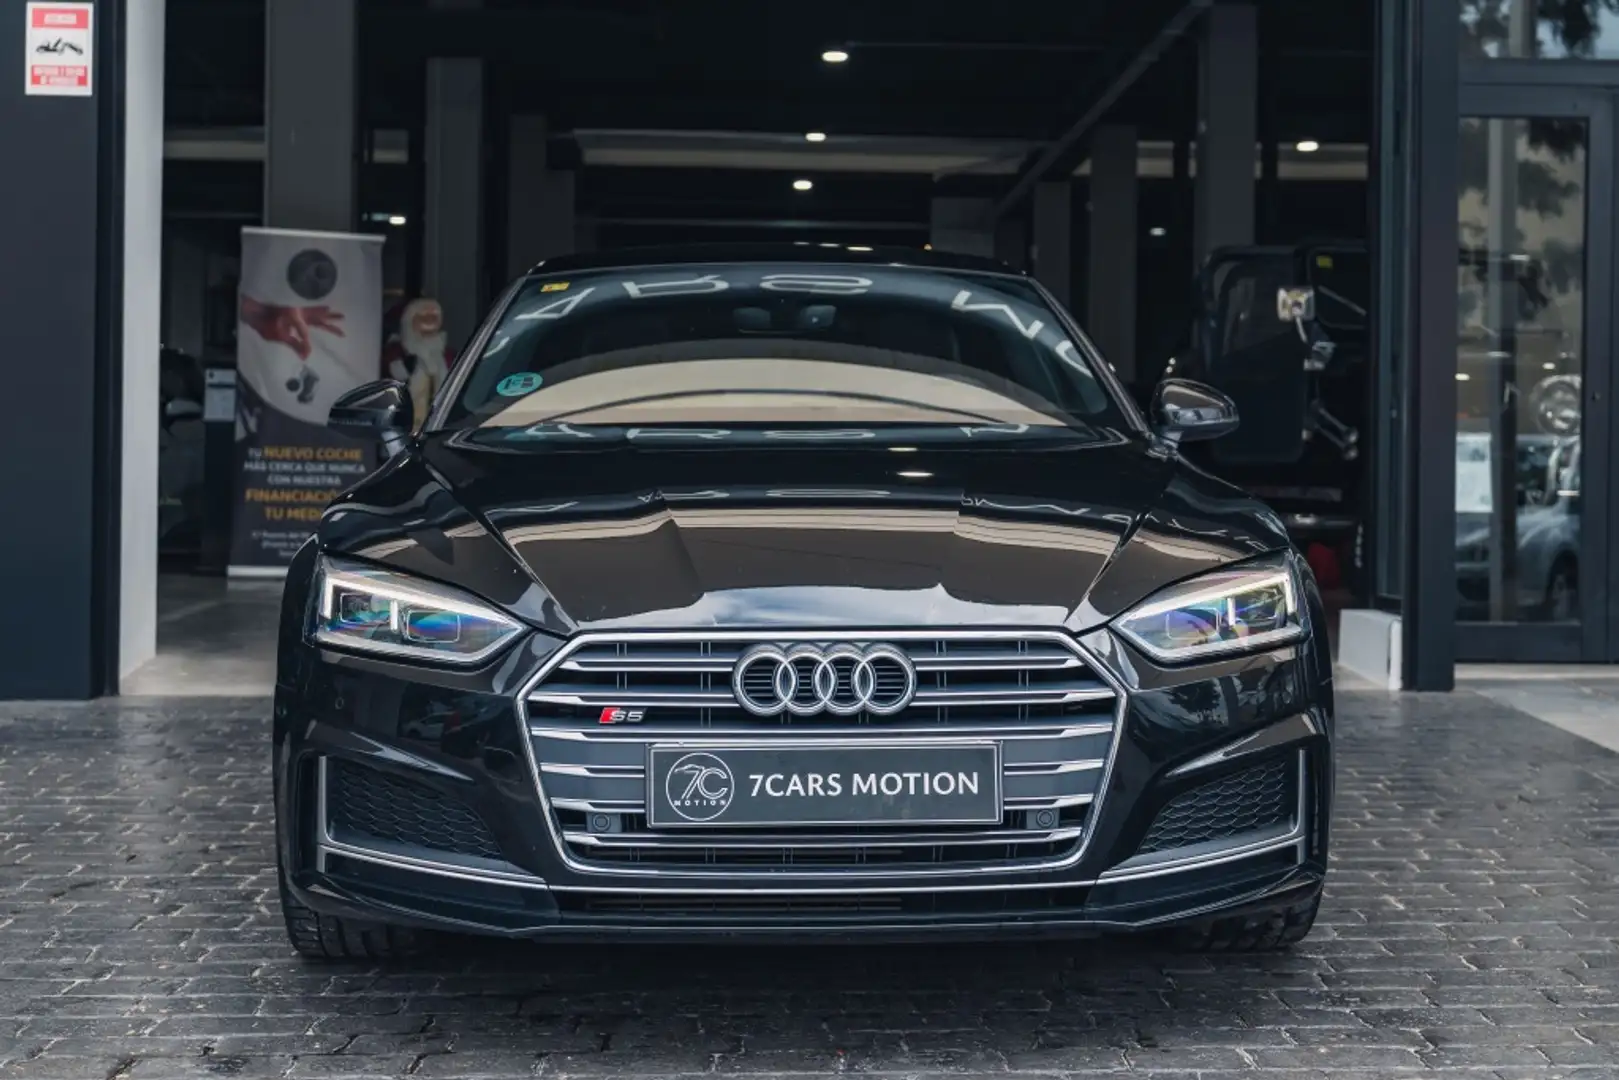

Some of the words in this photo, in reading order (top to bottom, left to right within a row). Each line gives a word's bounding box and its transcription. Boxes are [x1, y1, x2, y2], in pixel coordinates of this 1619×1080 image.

[264, 446, 313, 459] NUEVO
[315, 447, 361, 460] COCHE
[304, 461, 325, 473] QUE
[267, 473, 291, 484] CON
[293, 474, 341, 485] NUESTRA
[265, 506, 283, 520] TU
[611, 709, 645, 722] S5
[749, 772, 842, 797] 7CARS
[852, 771, 979, 796] MOTION
[673, 799, 727, 807] MOTION
